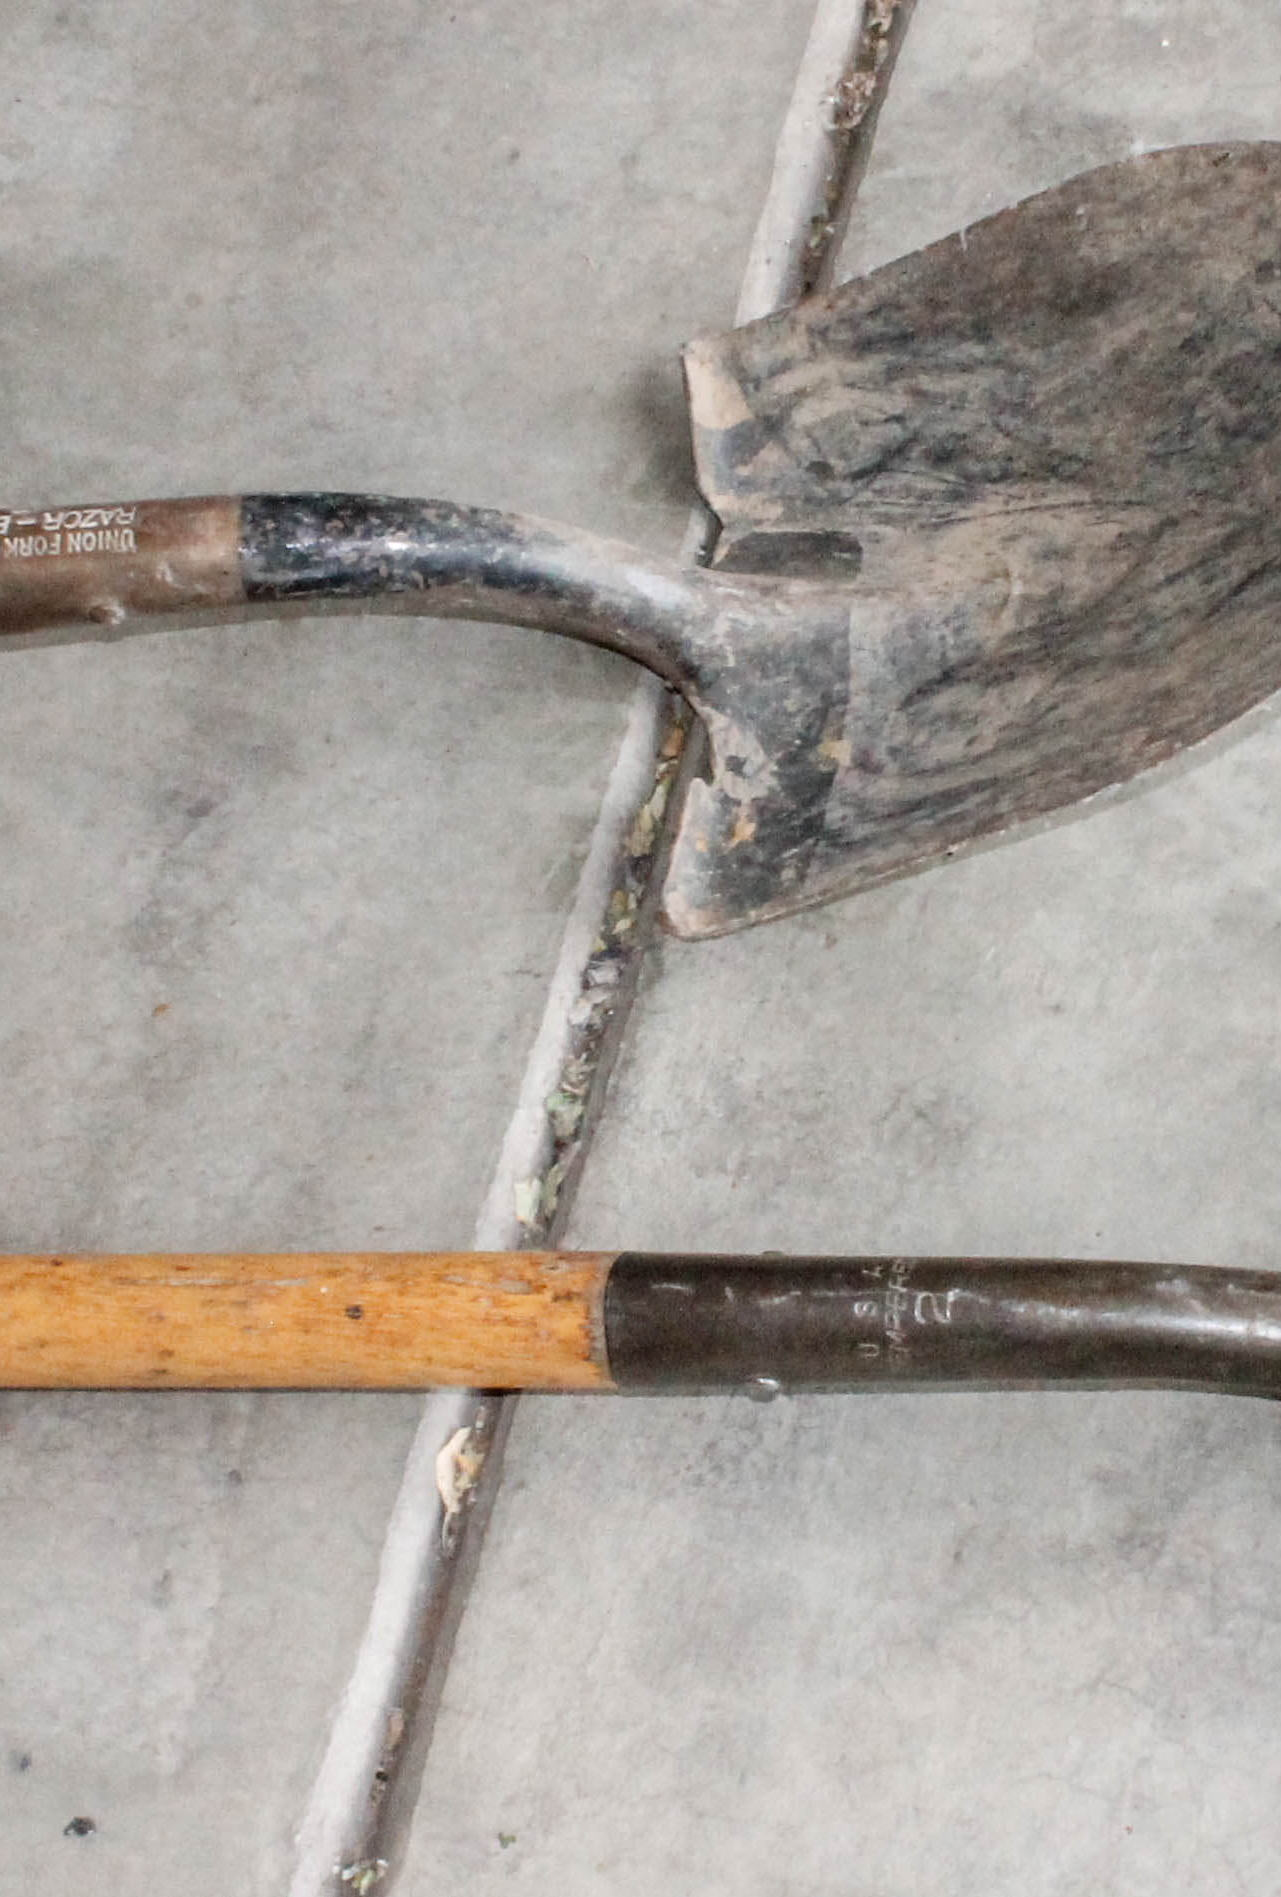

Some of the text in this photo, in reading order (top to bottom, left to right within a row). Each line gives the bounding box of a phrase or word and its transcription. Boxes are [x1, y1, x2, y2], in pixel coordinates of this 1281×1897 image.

[41, 506, 137, 531] RAZOR
[4, 532, 62, 557] FORK
[67, 527, 137, 553] UNION
[913, 1290, 952, 1325] 2
